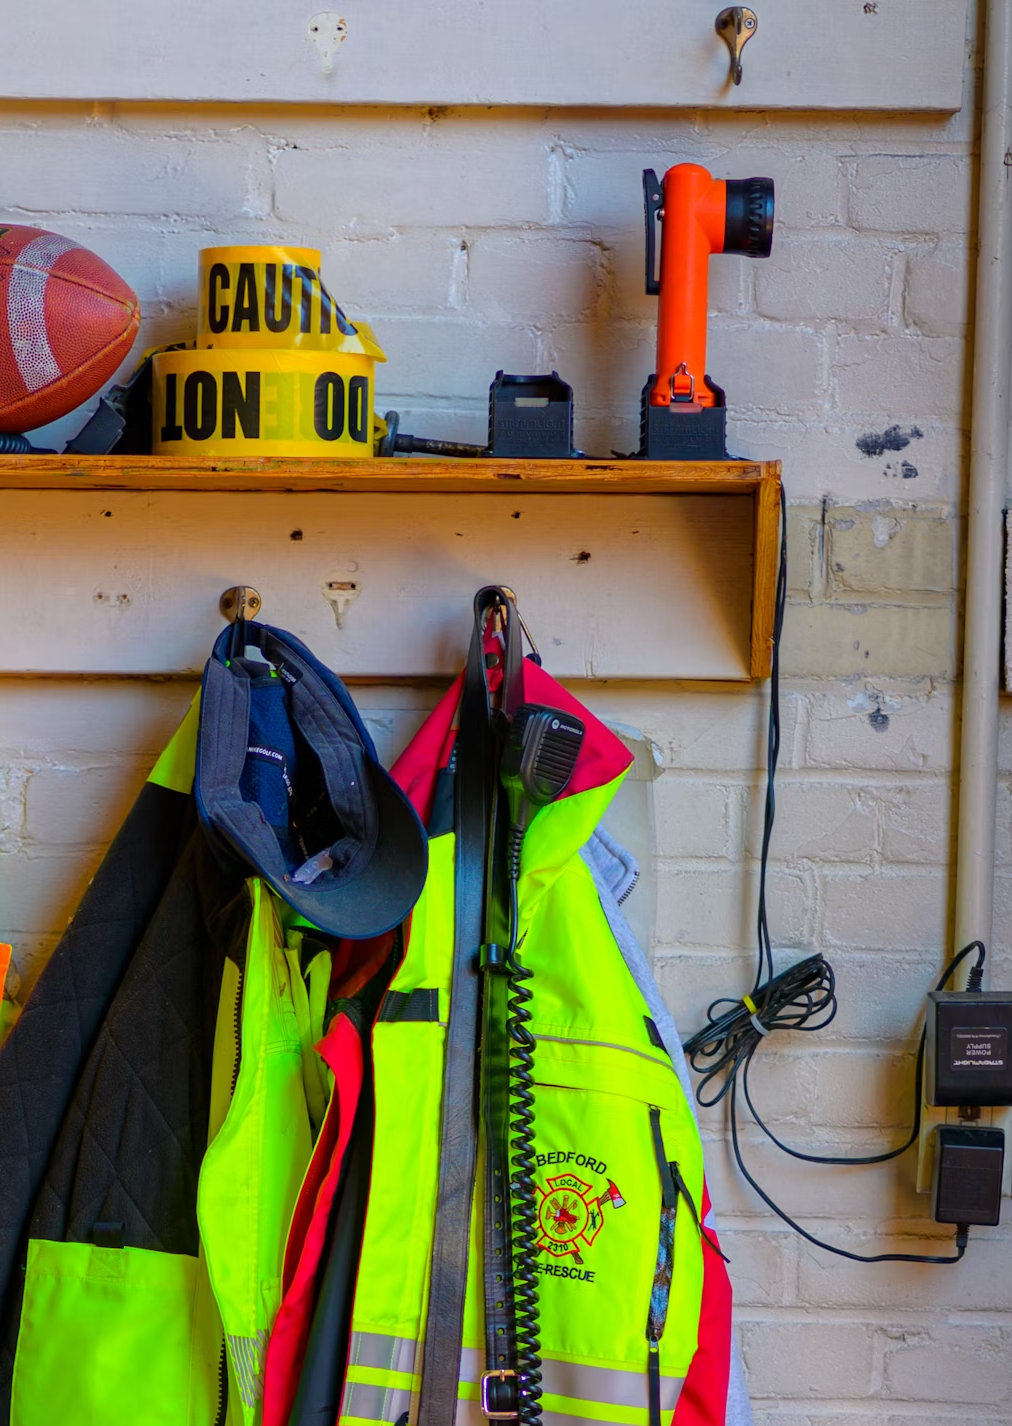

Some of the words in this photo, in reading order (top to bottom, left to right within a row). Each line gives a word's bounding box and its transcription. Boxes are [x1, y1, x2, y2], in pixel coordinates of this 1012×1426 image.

[160, 370, 261, 443] NOT
[313, 371, 369, 444] DO
[535, 1151, 607, 1175] BEDFORD
[554, 1178, 583, 1192] LOCAL
[548, 1241, 568, 1252] 2310
[517, 1263, 596, 1283] E-RESCUE
